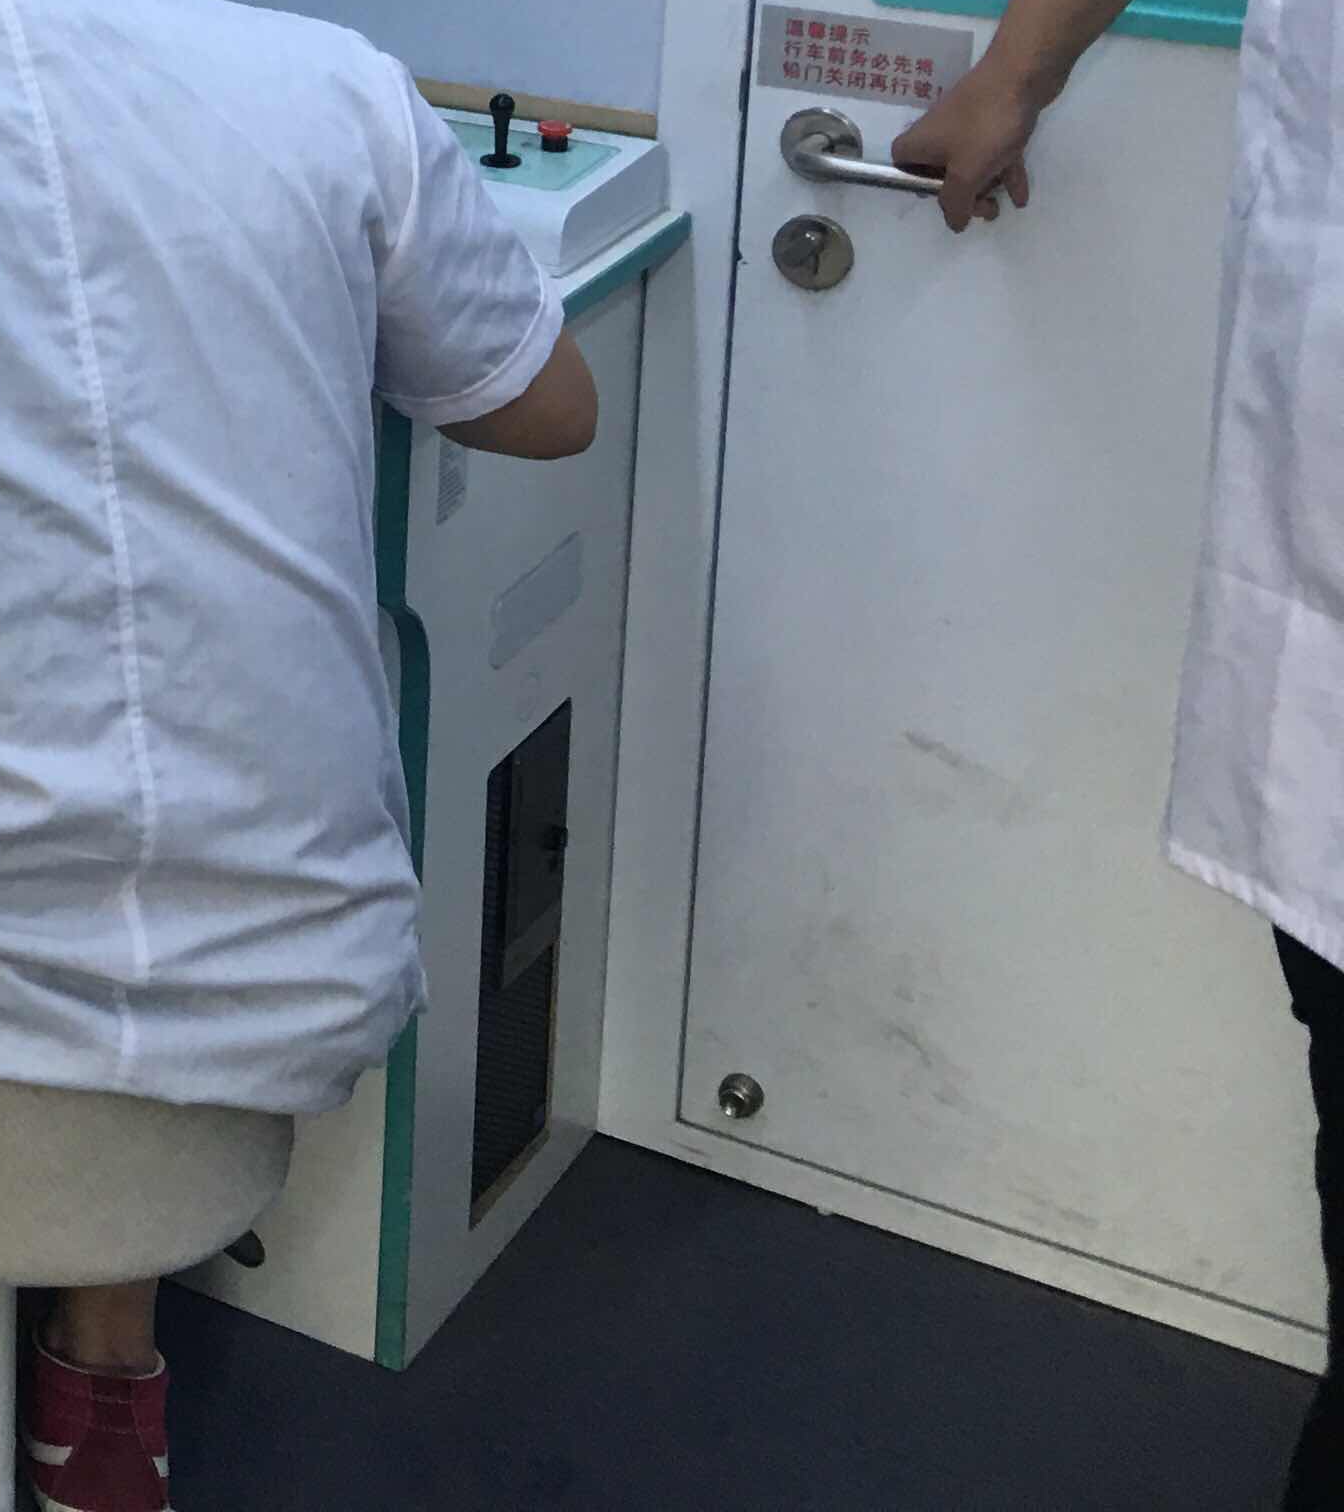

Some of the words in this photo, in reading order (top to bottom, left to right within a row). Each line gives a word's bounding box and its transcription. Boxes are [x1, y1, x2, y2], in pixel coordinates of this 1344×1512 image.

[785, 18, 871, 46] 温馨提示
[783, 40, 935, 76] 行车前务必先将
